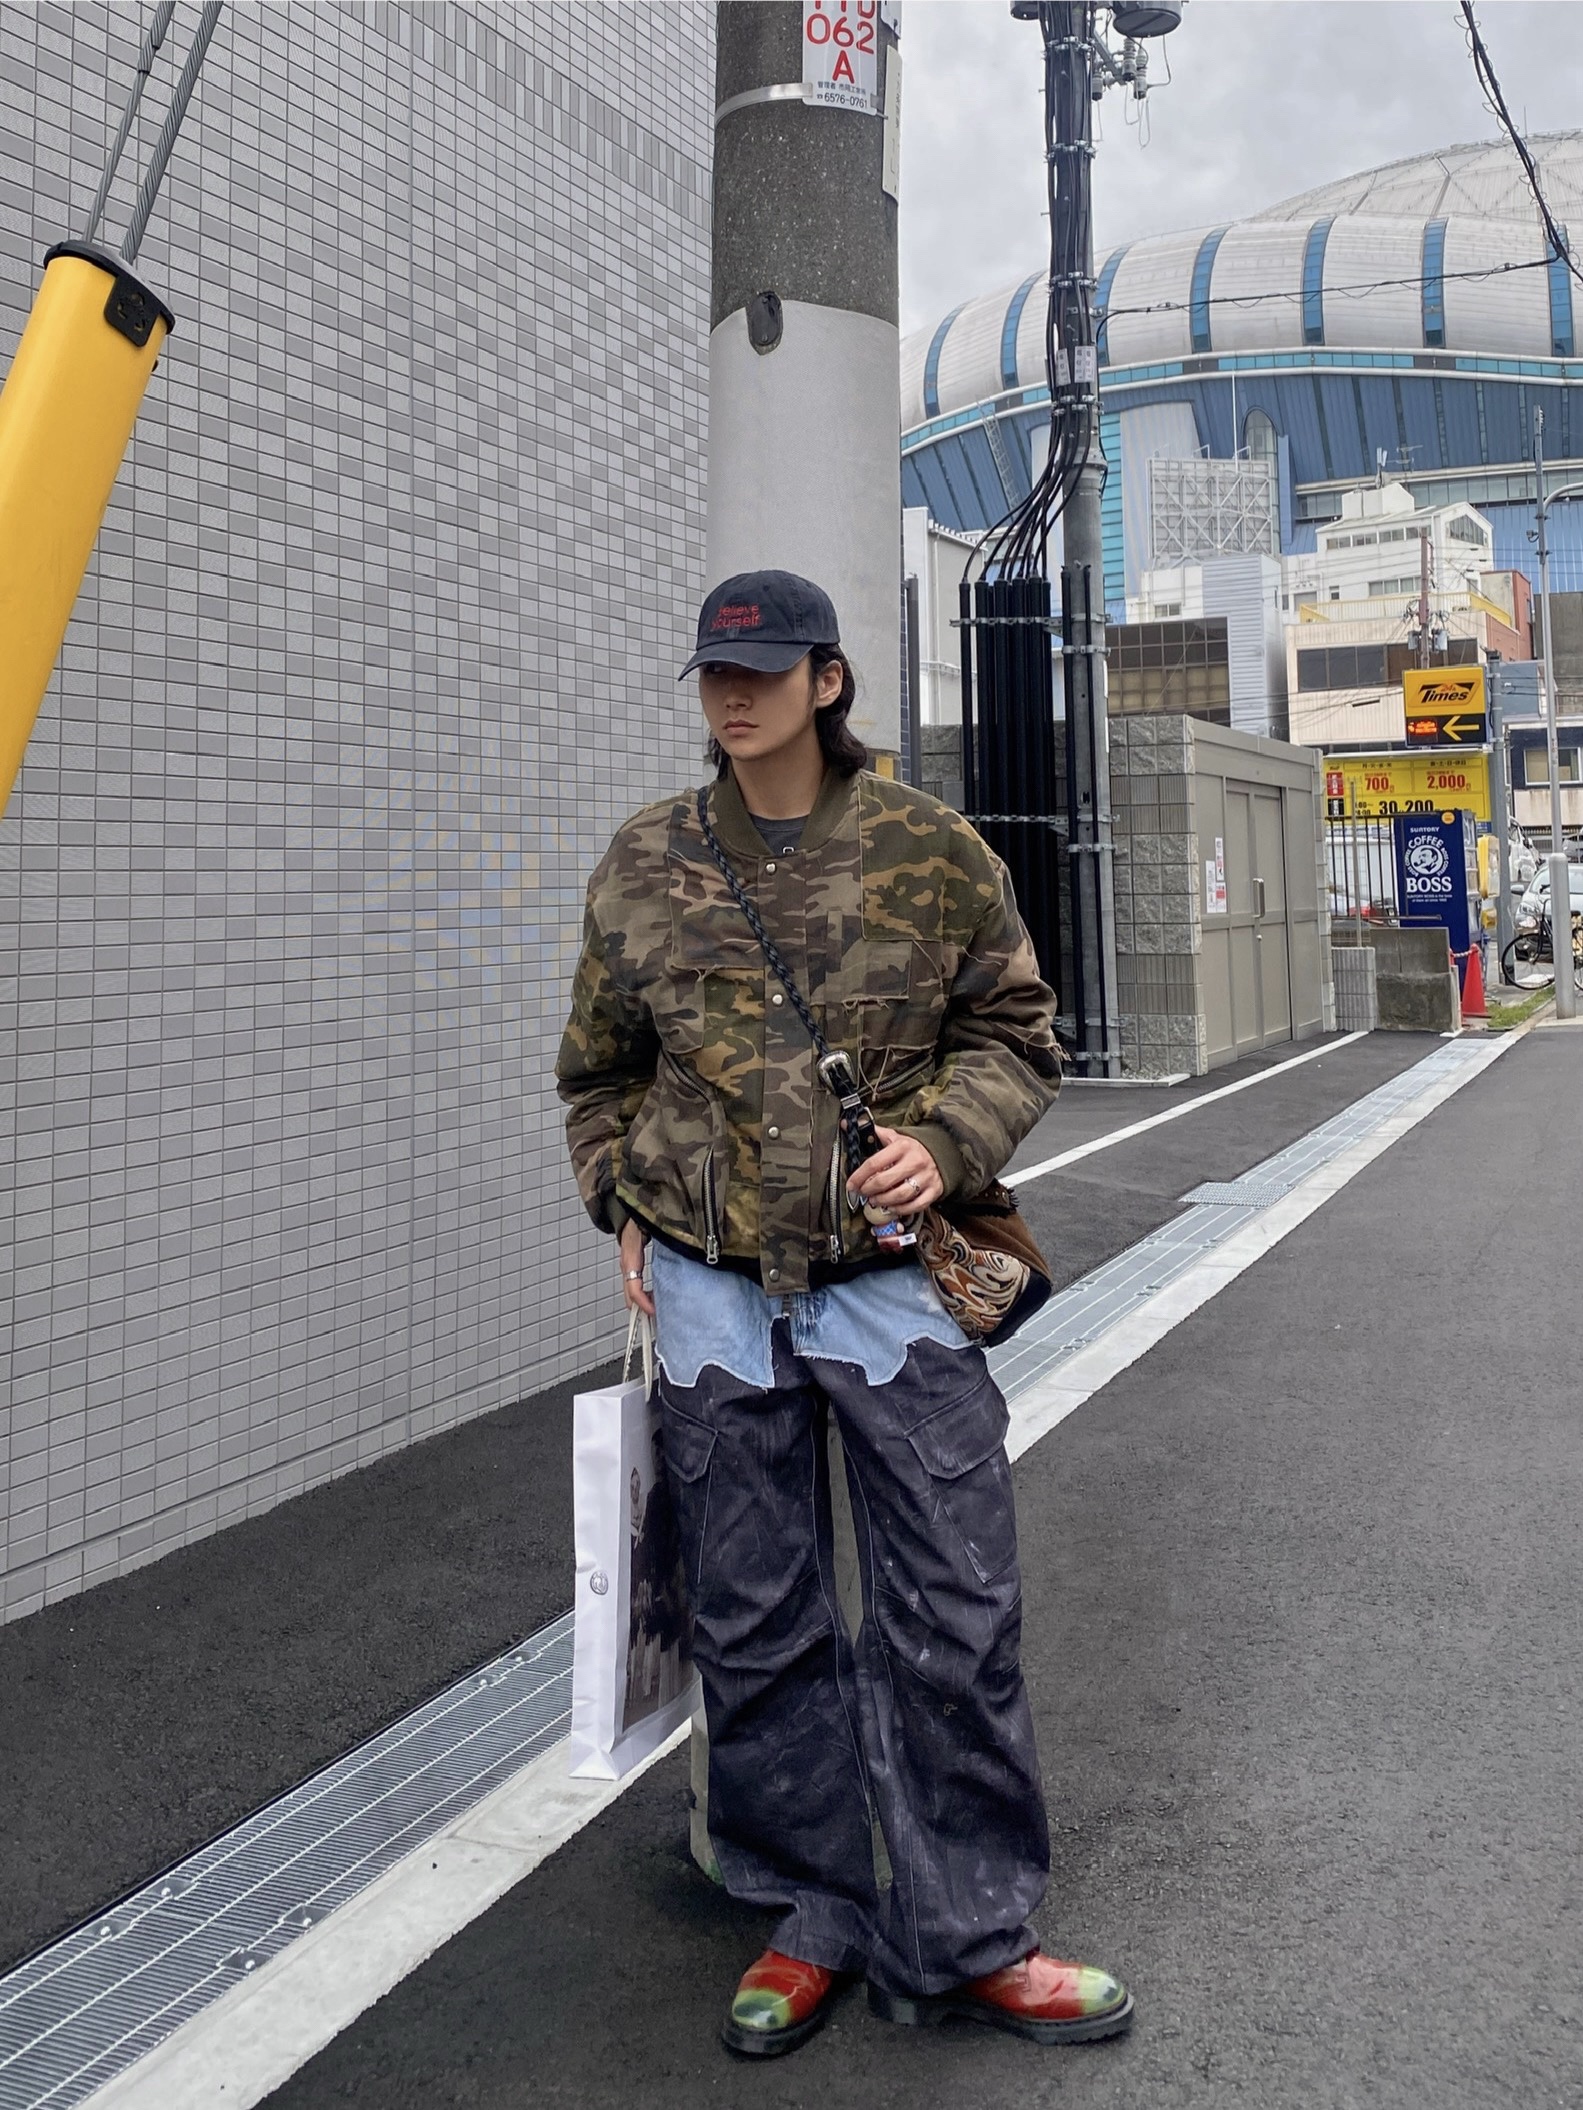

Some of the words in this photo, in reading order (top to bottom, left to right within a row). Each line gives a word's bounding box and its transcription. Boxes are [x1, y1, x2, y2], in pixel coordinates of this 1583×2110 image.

[806, 13, 875, 55] 062
[832, 49, 855, 84] A
[824, 92, 868, 109] 6576-0761
[1418, 682, 1475, 704] Times
[1365, 776, 1389, 791] 700
[1427, 774, 1466, 791] 2,000
[1379, 800, 1398, 815] 30
[1404, 799, 1434, 813] 200
[1408, 835, 1444, 849] COFFEE
[1406, 876, 1452, 893] BOSS
